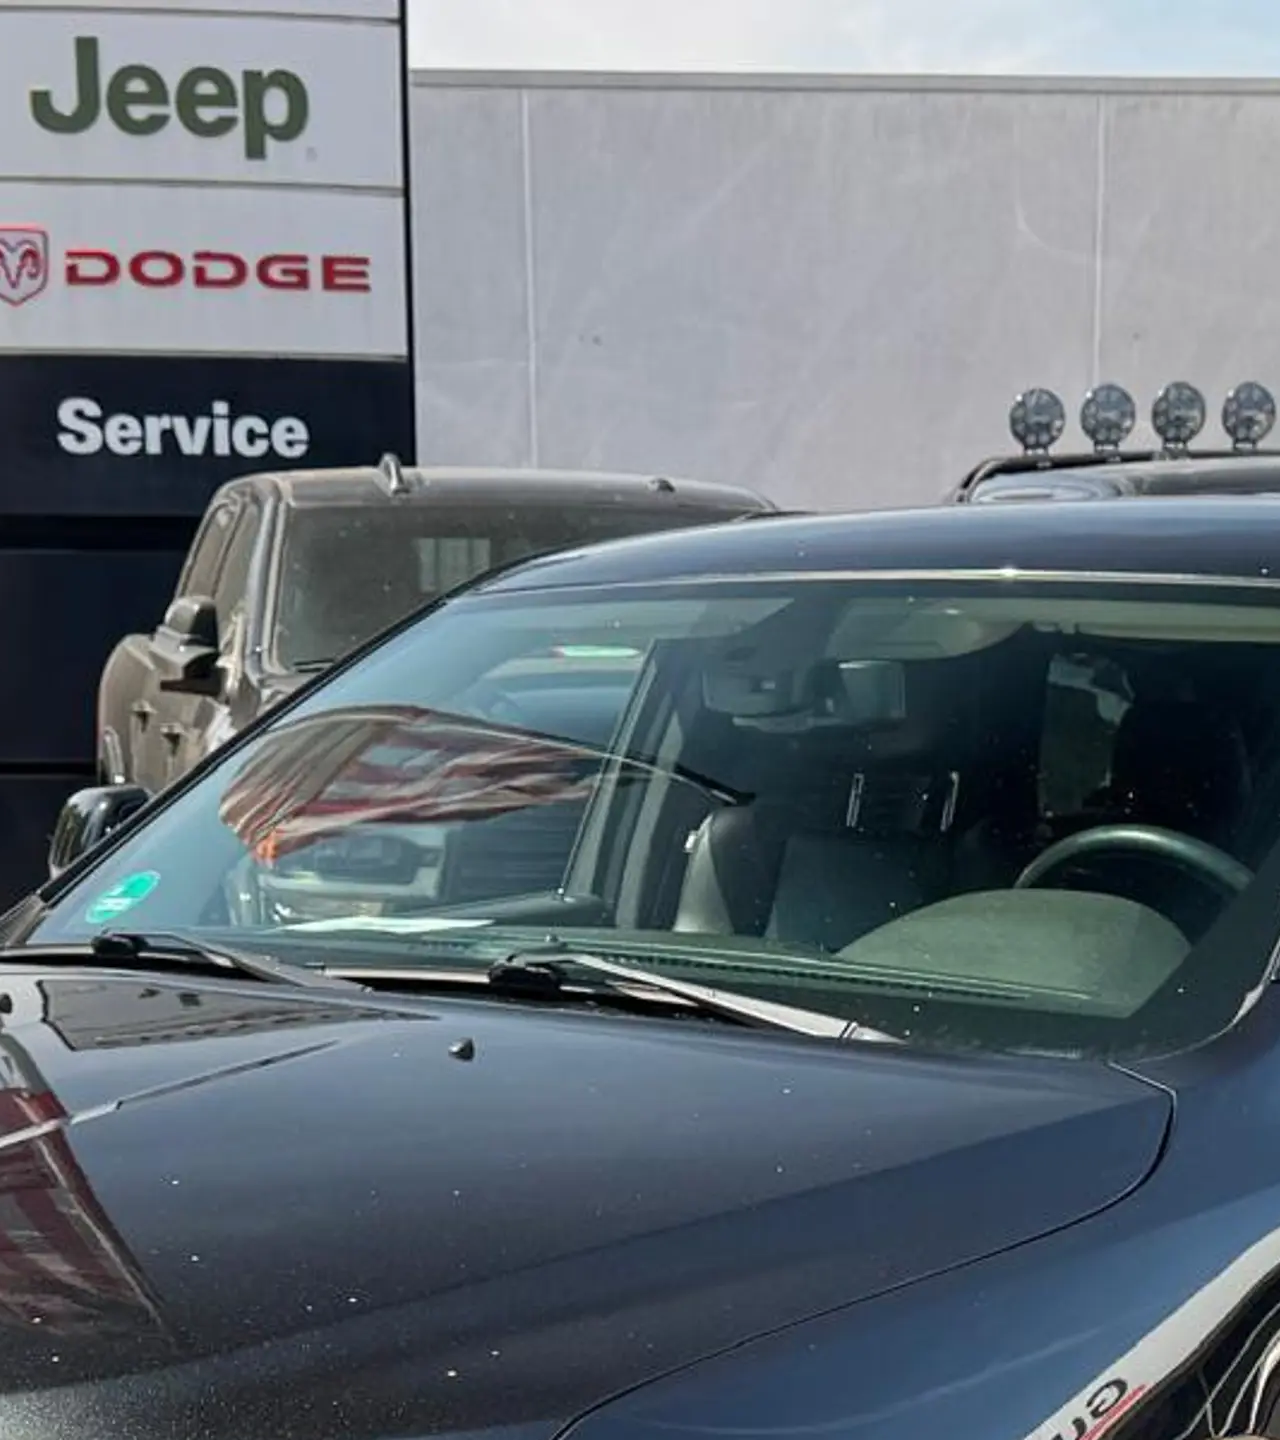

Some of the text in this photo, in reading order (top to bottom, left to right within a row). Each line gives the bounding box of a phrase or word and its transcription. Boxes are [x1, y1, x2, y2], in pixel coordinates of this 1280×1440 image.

[29, 36, 310, 160] Jeep
[65, 250, 372, 293] DODGE
[56, 397, 310, 458] Service
